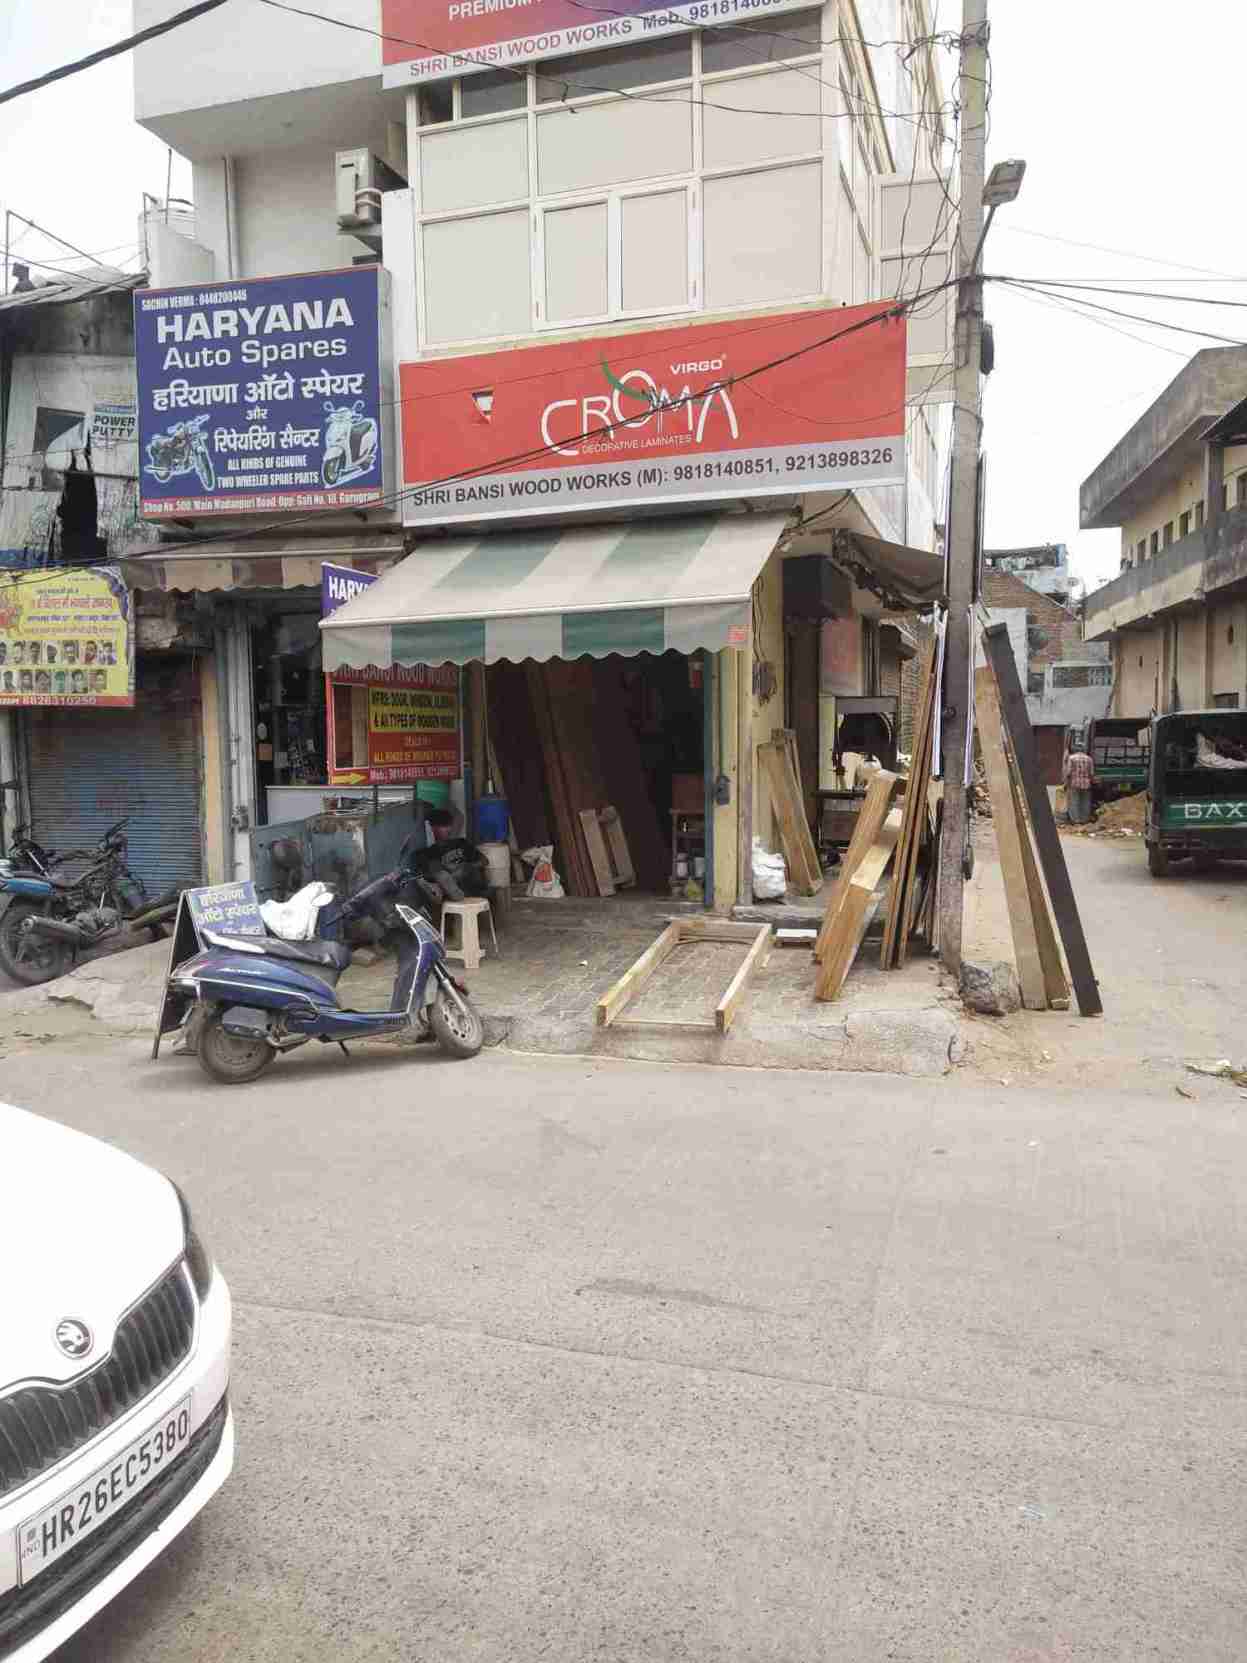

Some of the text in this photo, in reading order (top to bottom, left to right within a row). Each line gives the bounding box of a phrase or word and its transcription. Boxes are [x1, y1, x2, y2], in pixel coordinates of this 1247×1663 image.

[410, 58, 447, 77] SHRI
[452, 46, 502, 68] BANSI
[507, 34, 561, 57] WOOD
[566, 20, 632, 45] WORKS
[157, 298, 354, 343] HARYANA
[163, 338, 347, 370] Auto Spares
[669, 359, 723, 375] VIRGO
[151, 379, 239, 411] हरियाणा
[301, 368, 365, 398] स्पेयर
[95, 415, 136, 426] POWER
[246, 405, 268, 420] और
[541, 369, 739, 456] CROMA
[93, 426, 134, 437] PUTTY
[214, 425, 275, 453] रिपेयरिंग
[582, 434, 692, 454] DECORATIVE LAMINATES
[228, 459, 240, 470] ALL
[265, 457, 274, 468] OF
[276, 455, 307, 468] GENUINE
[217, 476, 234, 488] TWO
[236, 474, 269, 488] WHEELER
[294, 472, 319, 484] PARTS
[414, 448, 893, 506] SHRI BANSI WOOD WORKS (M): 9818140851, 9213898326
[41, 1409, 189, 1557] HR26EC5380
